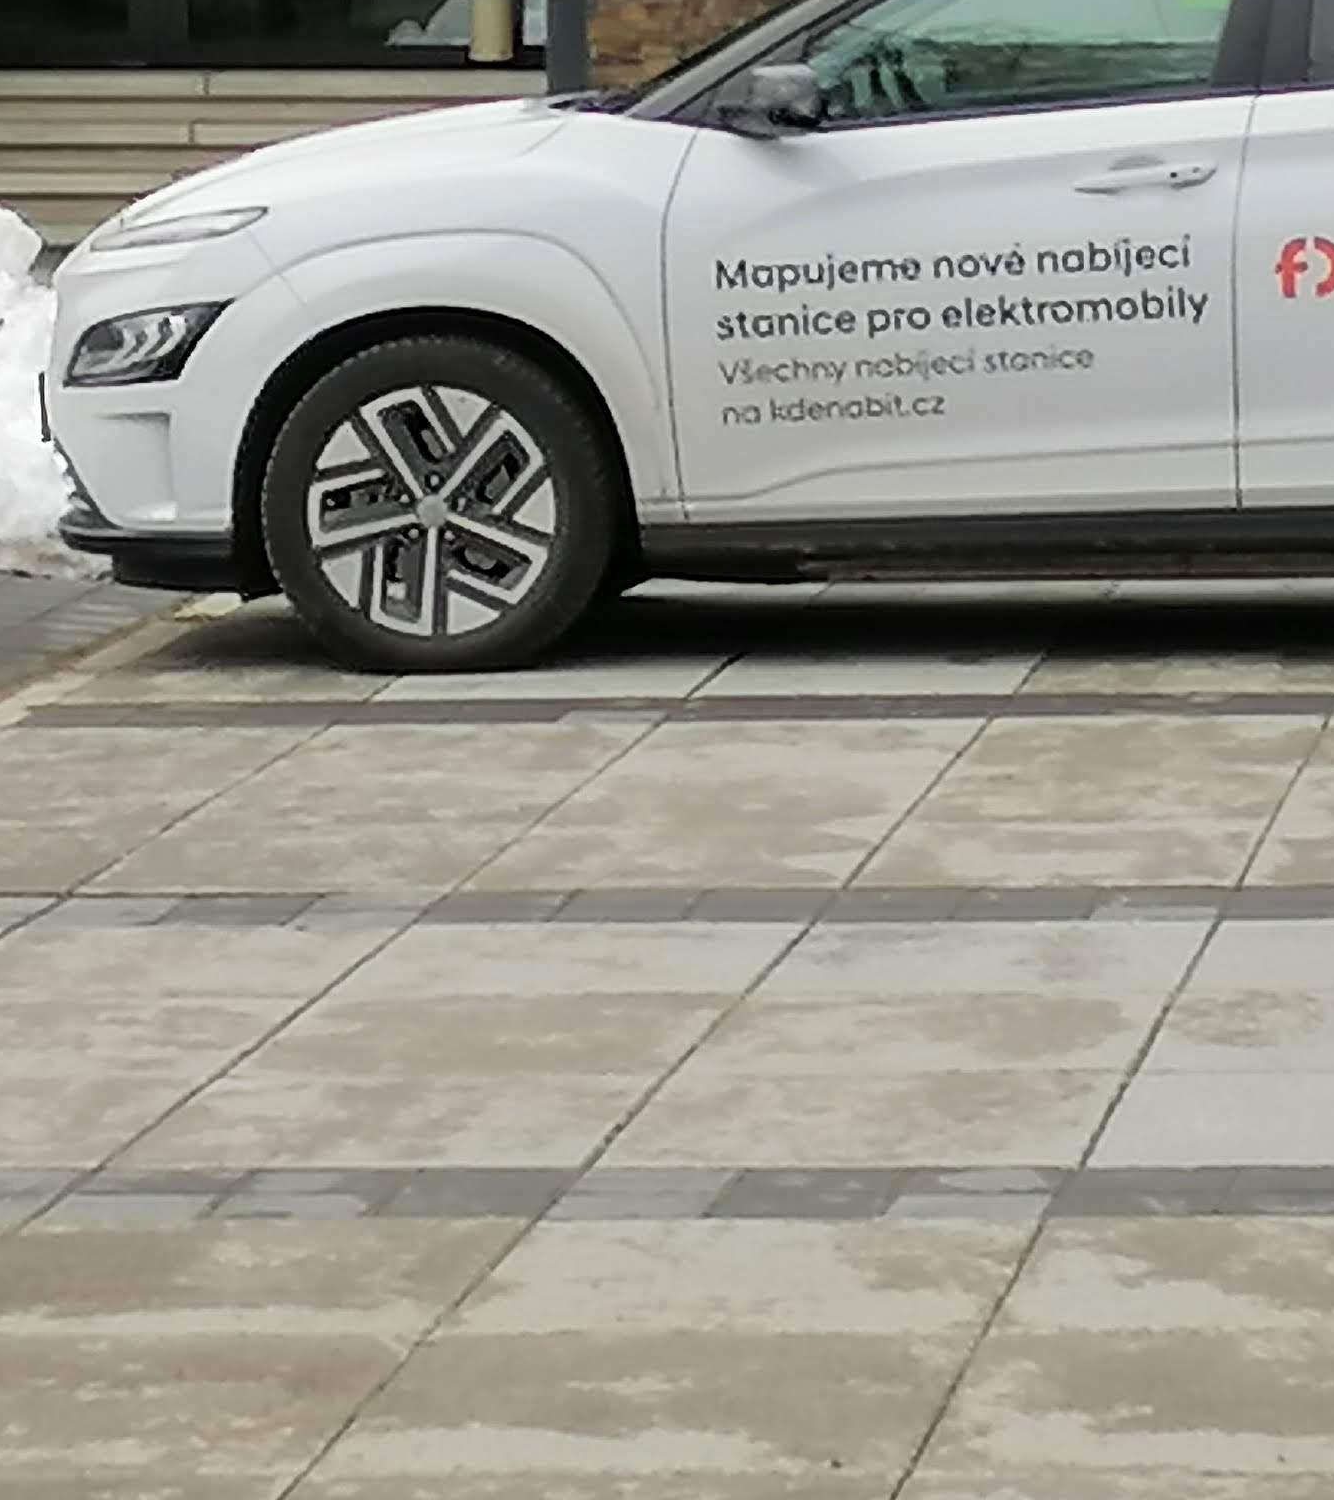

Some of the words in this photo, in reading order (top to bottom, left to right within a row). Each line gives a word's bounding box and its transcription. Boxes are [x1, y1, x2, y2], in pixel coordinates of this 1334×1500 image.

[716, 253, 921, 293] Mapujeme
[933, 243, 1025, 279] nové
[717, 303, 856, 340] stanice
[867, 306, 931, 339] pro
[941, 285, 1208, 329] elektromobily
[718, 357, 847, 388] Všechny
[983, 345, 1095, 374] stanice
[723, 404, 762, 426] na
[769, 393, 946, 422] kdenabit.cz
